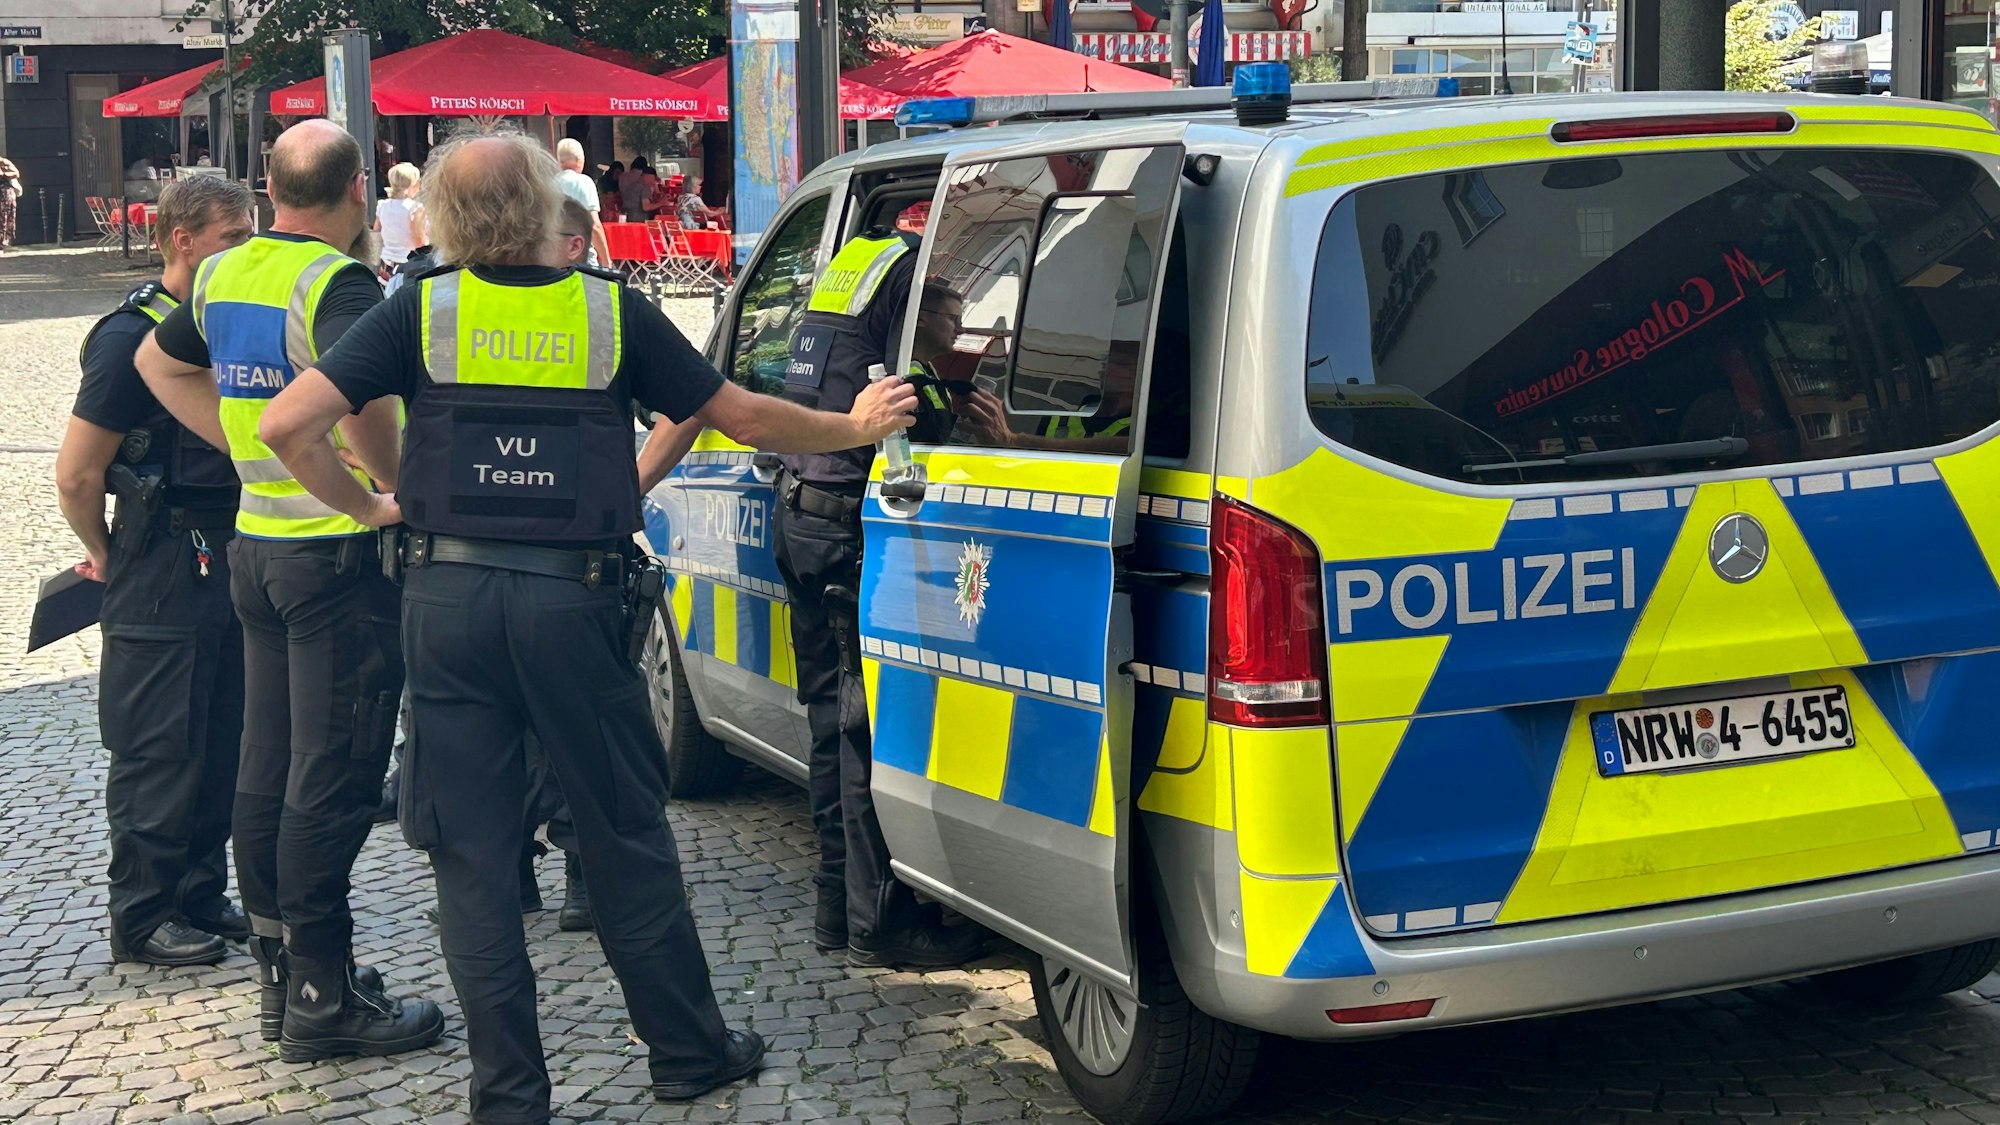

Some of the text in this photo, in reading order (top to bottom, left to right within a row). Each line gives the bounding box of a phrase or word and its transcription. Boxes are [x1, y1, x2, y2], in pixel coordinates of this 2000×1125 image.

[1467, 3, 1545, 12] INTERNAIONAL AG
[3, 28, 38, 36] Alter Markt
[431, 96, 477, 109] PETERS
[610, 97, 654, 110] PETERS
[470, 328, 576, 364] POLIZEI
[800, 336, 815, 352] VU
[214, 362, 285, 388] U-TEAM
[788, 358, 813, 376] Team
[495, 436, 536, 457] VU
[473, 464, 555, 486] Team
[705, 492, 766, 549] POLIZEI
[1335, 546, 1636, 635] POLIZEI
[1603, 692, 1848, 765] D NRW 4-6455
